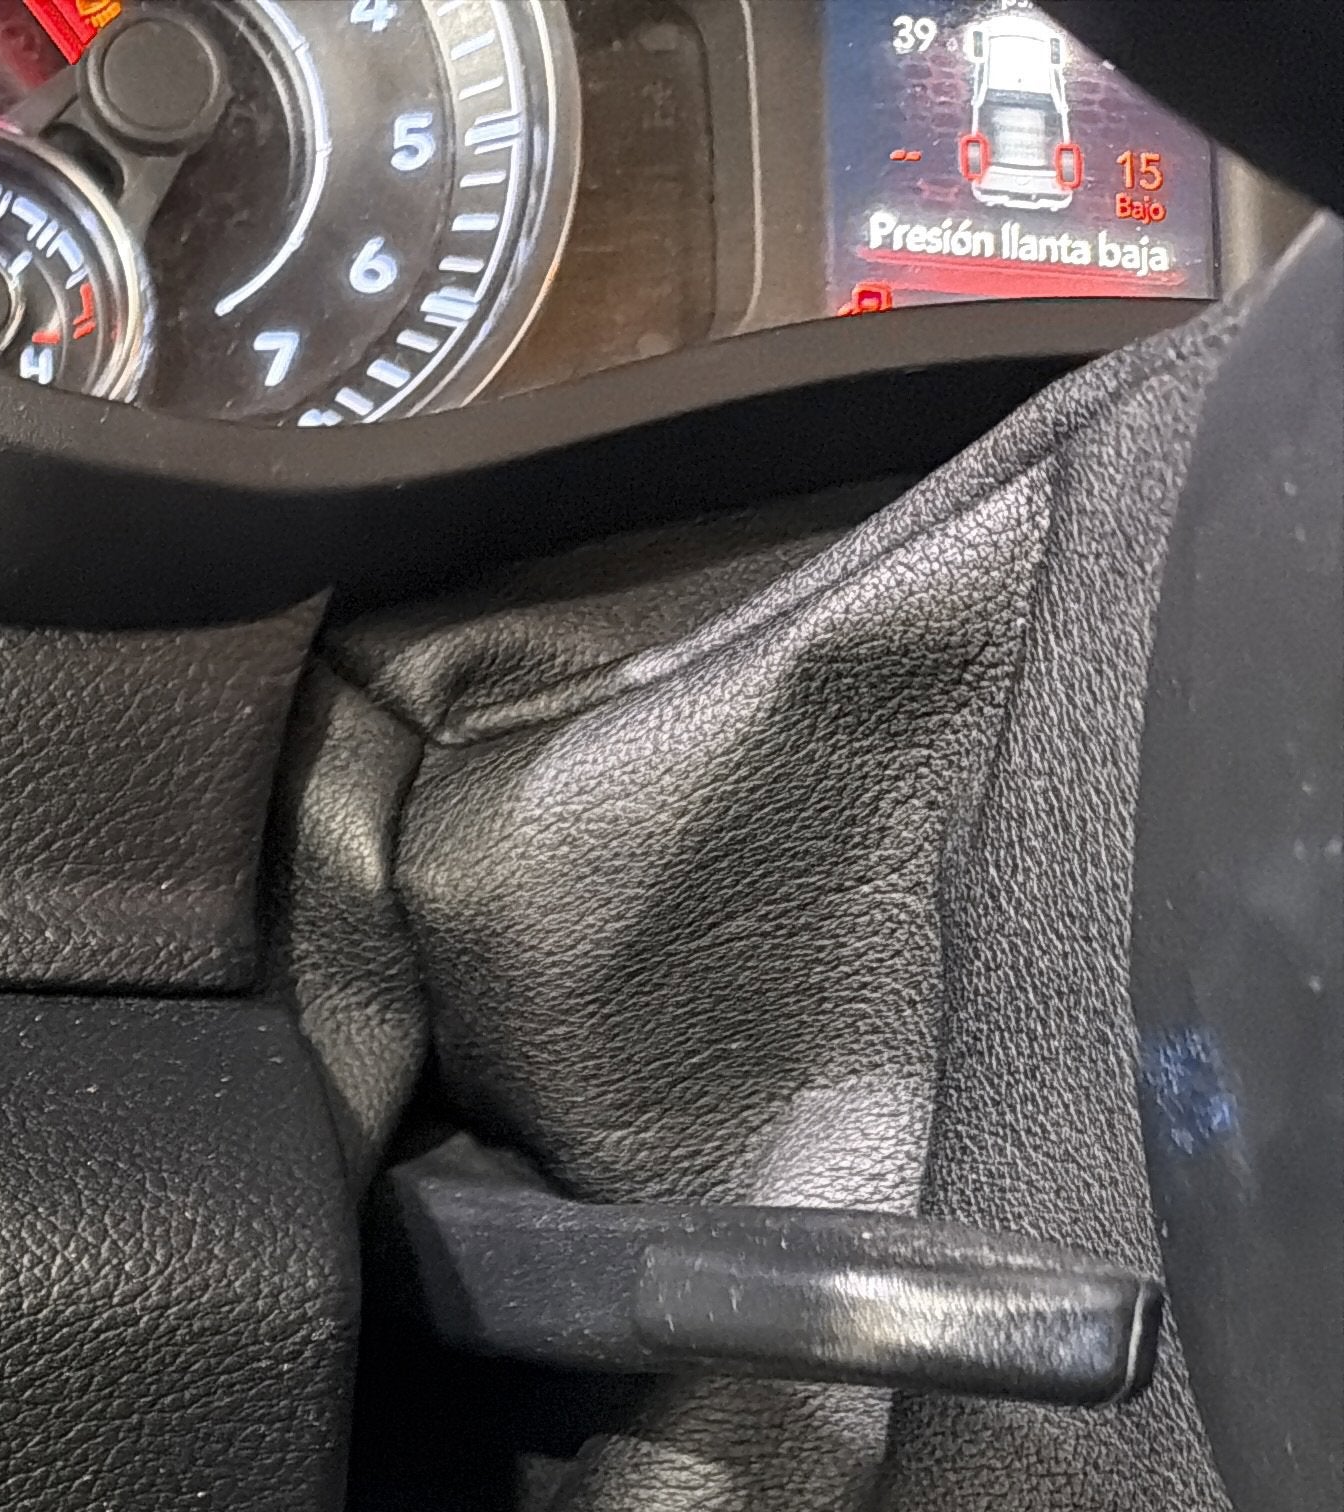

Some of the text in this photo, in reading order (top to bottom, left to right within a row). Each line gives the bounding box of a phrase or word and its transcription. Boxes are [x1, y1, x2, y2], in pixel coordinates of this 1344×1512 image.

[350, 0, 398, 32] 4
[892, 15, 938, 54] 39
[390, 111, 436, 171] 5
[1115, 150, 1164, 190] 15
[1115, 192, 1167, 224] Bajo
[349, 236, 398, 294] 6
[868, 209, 1170, 277] Presión llanta baja
[253, 331, 300, 387] 7
